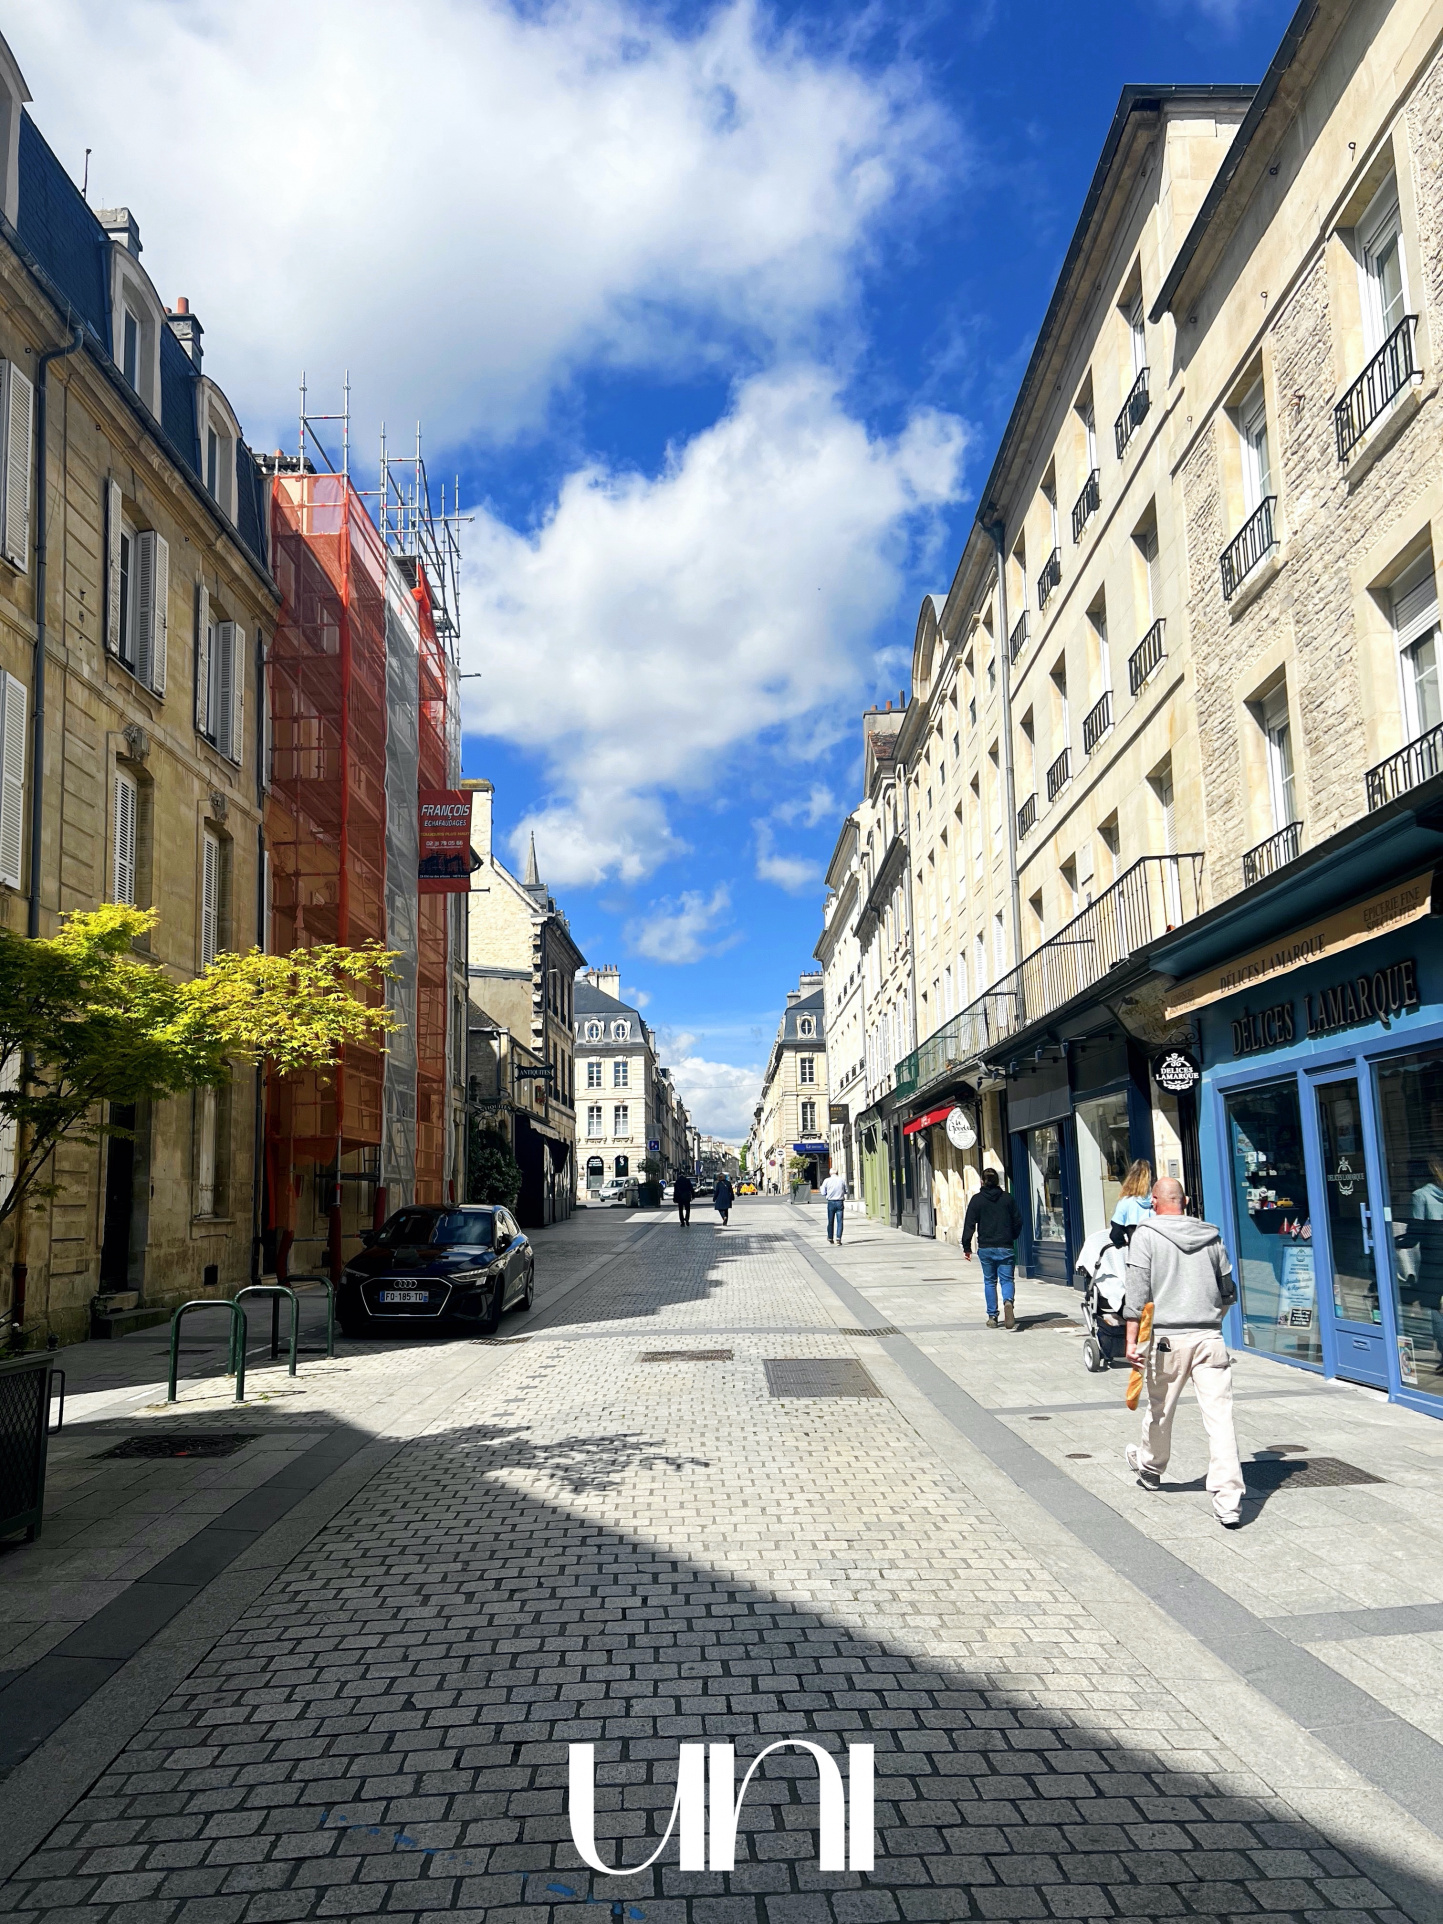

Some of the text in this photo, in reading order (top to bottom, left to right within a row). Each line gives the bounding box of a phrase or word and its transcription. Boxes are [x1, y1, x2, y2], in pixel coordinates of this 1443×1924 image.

[421, 804, 470, 819] FRANÇOIS
[1400, 886, 1420, 905] FINE
[1220, 933, 1326, 995] DÉLICES LAMARQUE
[1231, 960, 1419, 1056] DÉLICES LAMARQUE
[1155, 1072, 1200, 1081] LAMARQUE
[1160, 1066, 1194, 1075] DELICES
